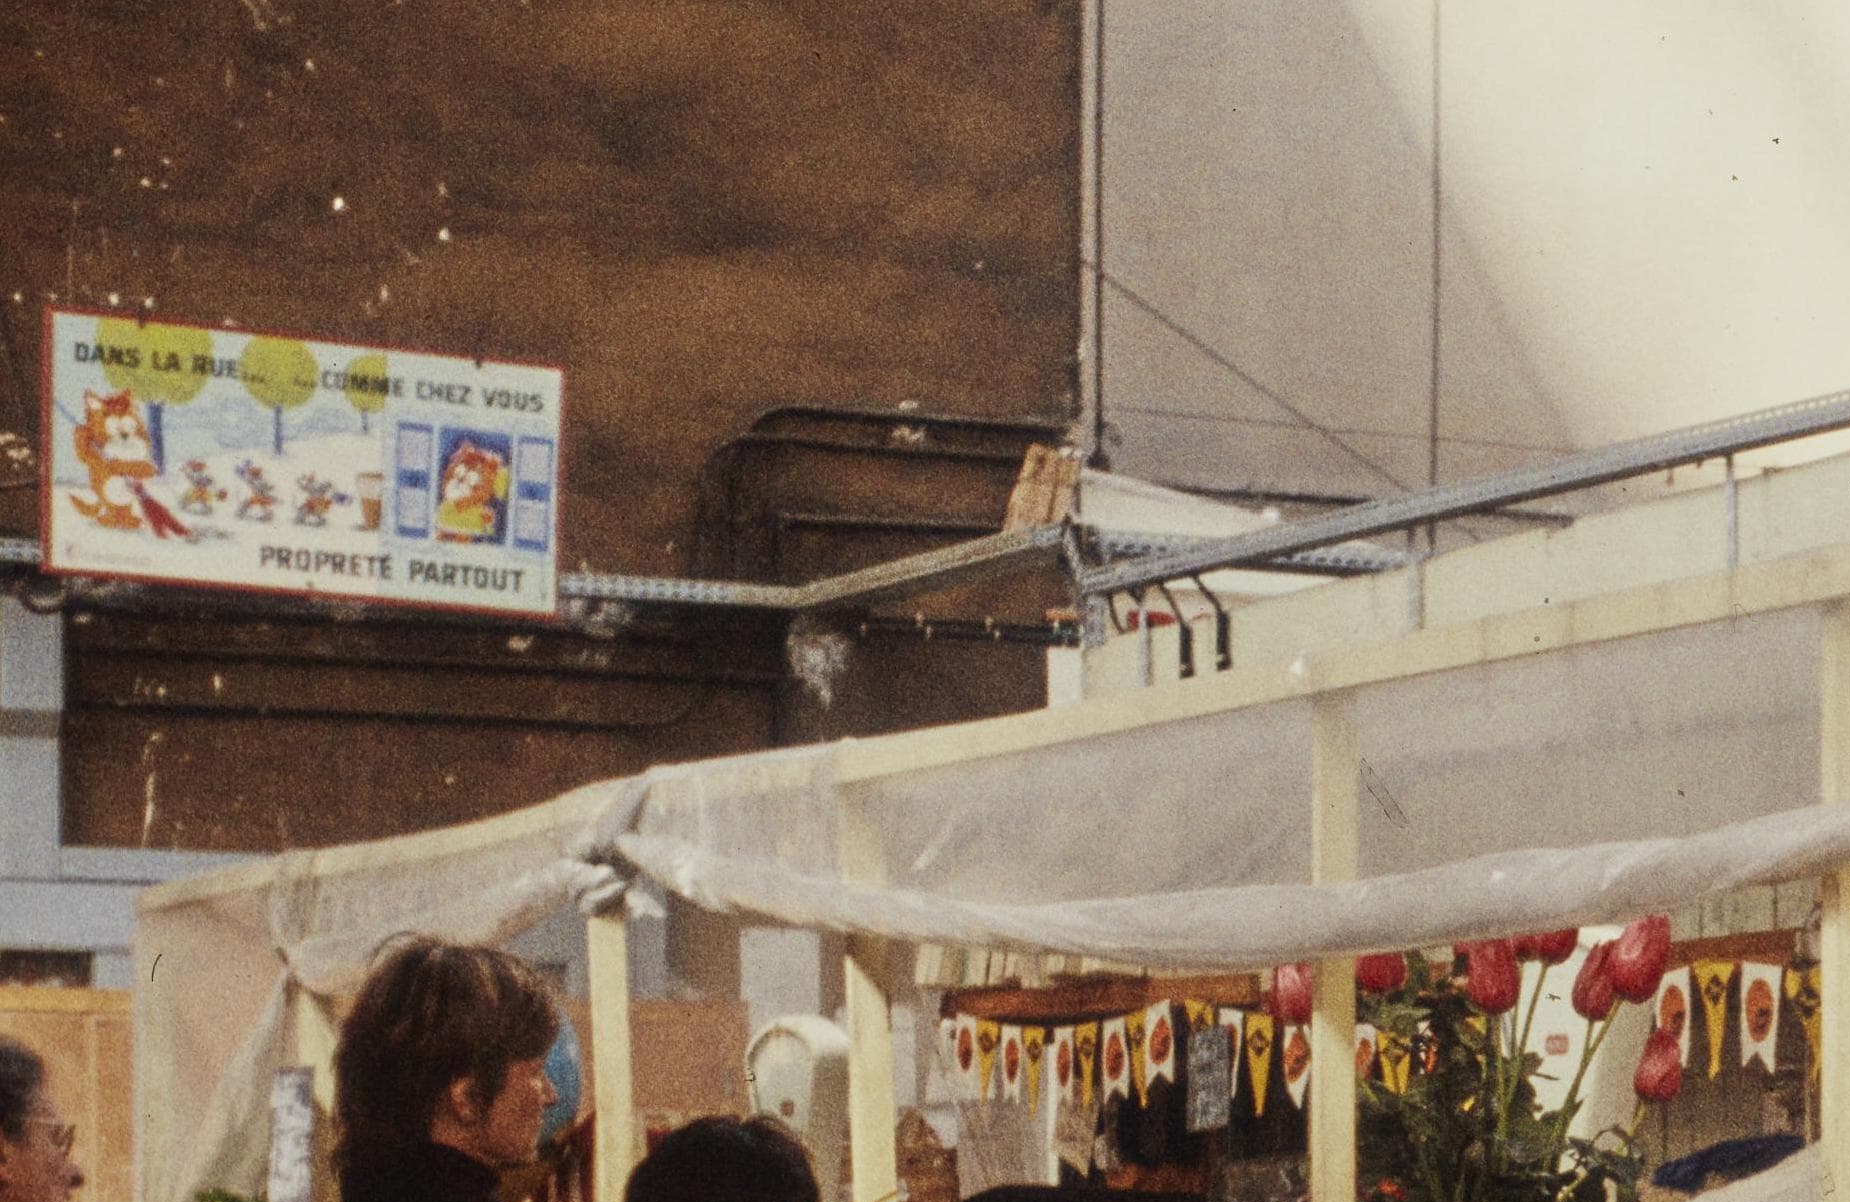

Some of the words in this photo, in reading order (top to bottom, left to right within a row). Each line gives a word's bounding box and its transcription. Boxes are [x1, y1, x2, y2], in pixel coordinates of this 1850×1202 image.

[74, 341, 140, 368] DANS
[152, 350, 181, 372] LA
[415, 381, 471, 406] CHEZ
[482, 388, 543, 413] VOUS
[260, 544, 393, 579] PROPRETÉ
[408, 558, 525, 594] PARTOUT
